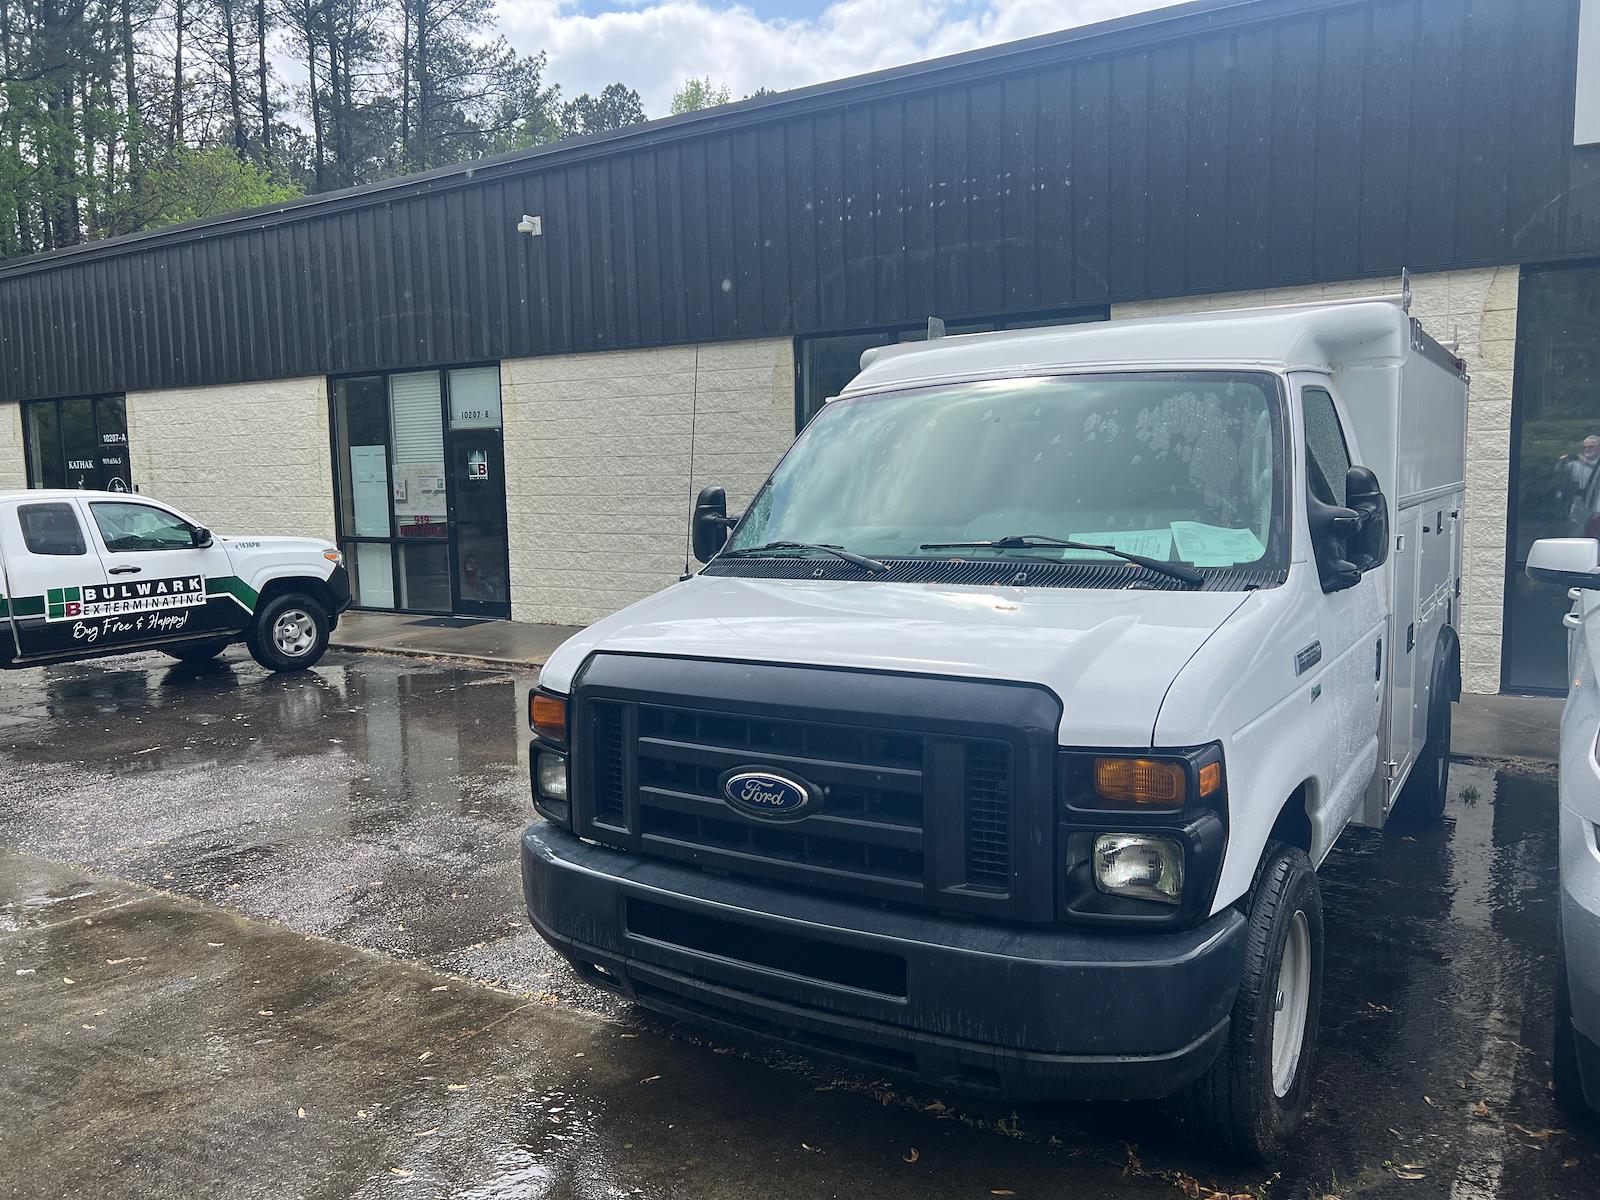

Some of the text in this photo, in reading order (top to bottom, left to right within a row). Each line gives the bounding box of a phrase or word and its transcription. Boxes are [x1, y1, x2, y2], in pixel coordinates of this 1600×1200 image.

[68, 460, 94, 470] KATHAK
[478, 464, 487, 476] B
[414, 515, 430, 525] 919
[84, 578, 201, 602] BULWARK
[66, 602, 82, 618] B
[83, 593, 204, 616] EXTERMINATING
[72, 610, 189, 643] Bug Free & Happy!
[741, 779, 786, 806] Ford
